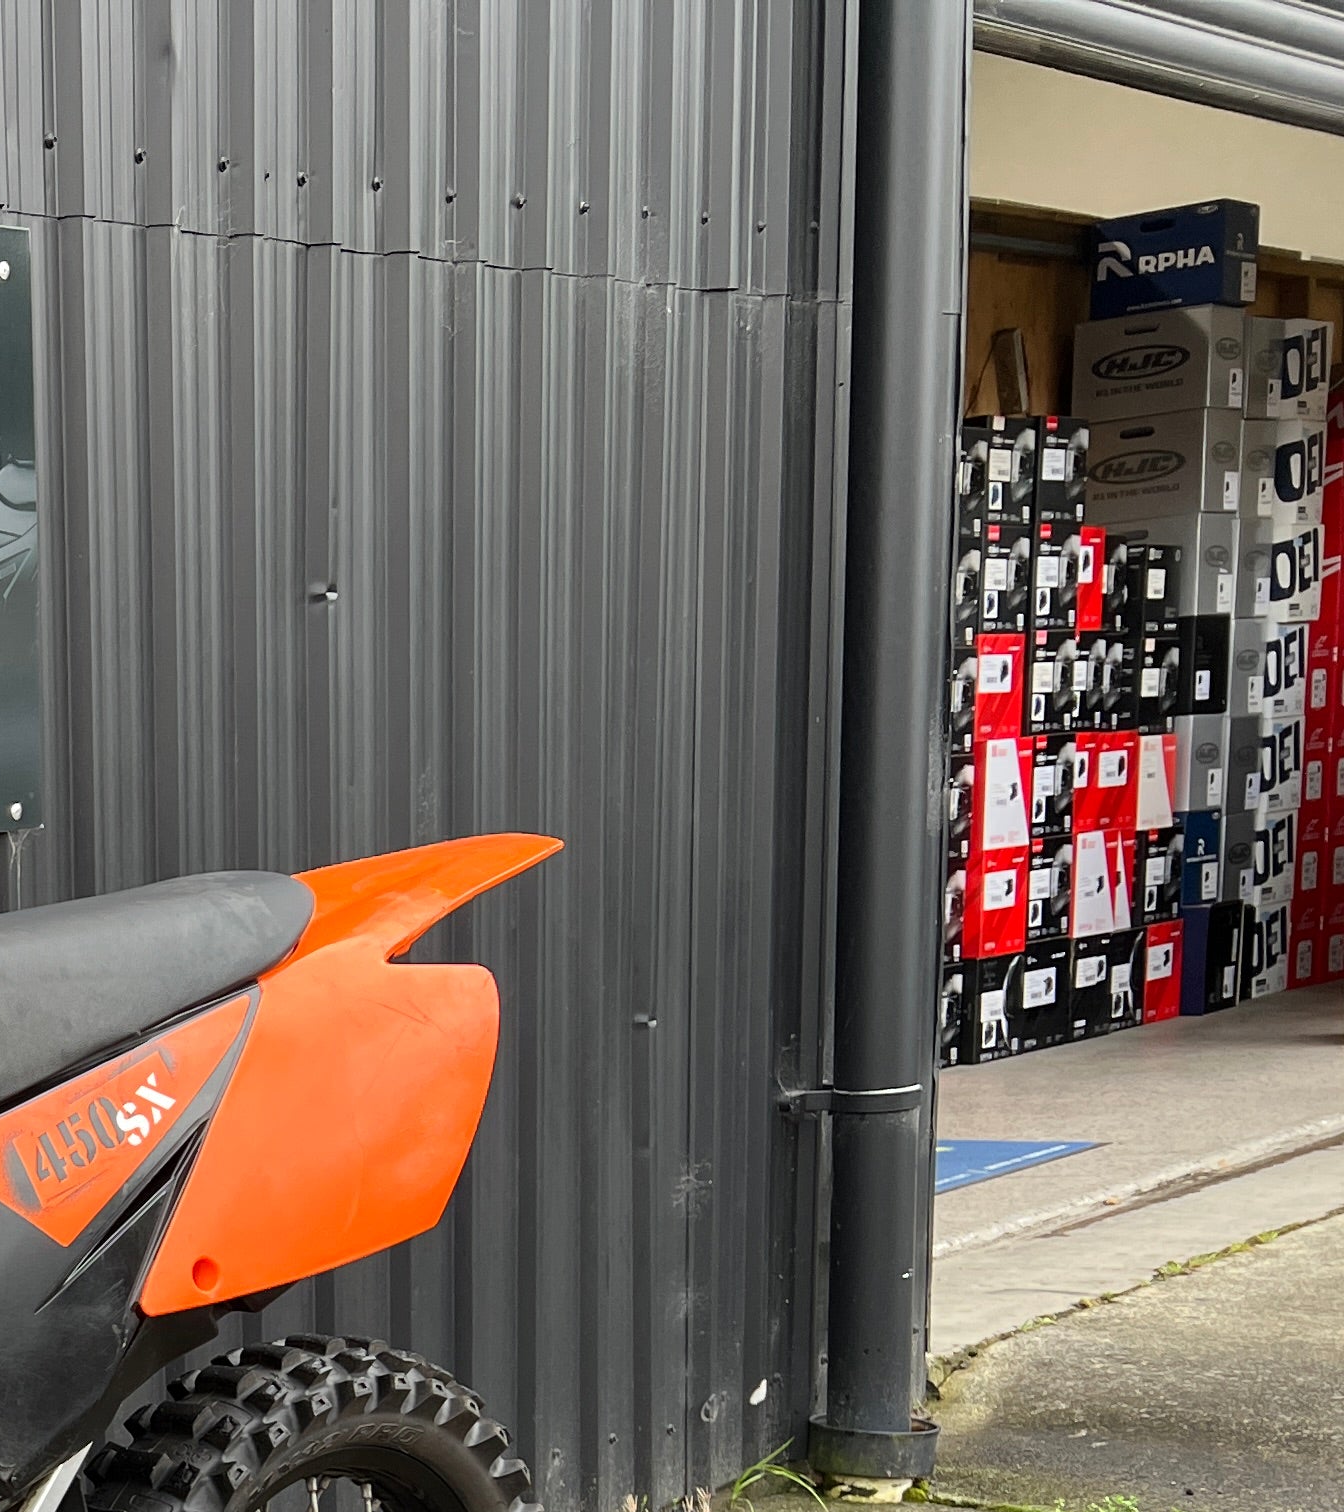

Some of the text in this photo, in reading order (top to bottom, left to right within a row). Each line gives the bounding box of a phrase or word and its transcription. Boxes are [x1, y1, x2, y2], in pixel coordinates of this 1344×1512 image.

[1137, 245, 1215, 275] RPHA
[1105, 349, 1180, 376] HJC
[1101, 455, 1175, 480] HJC
